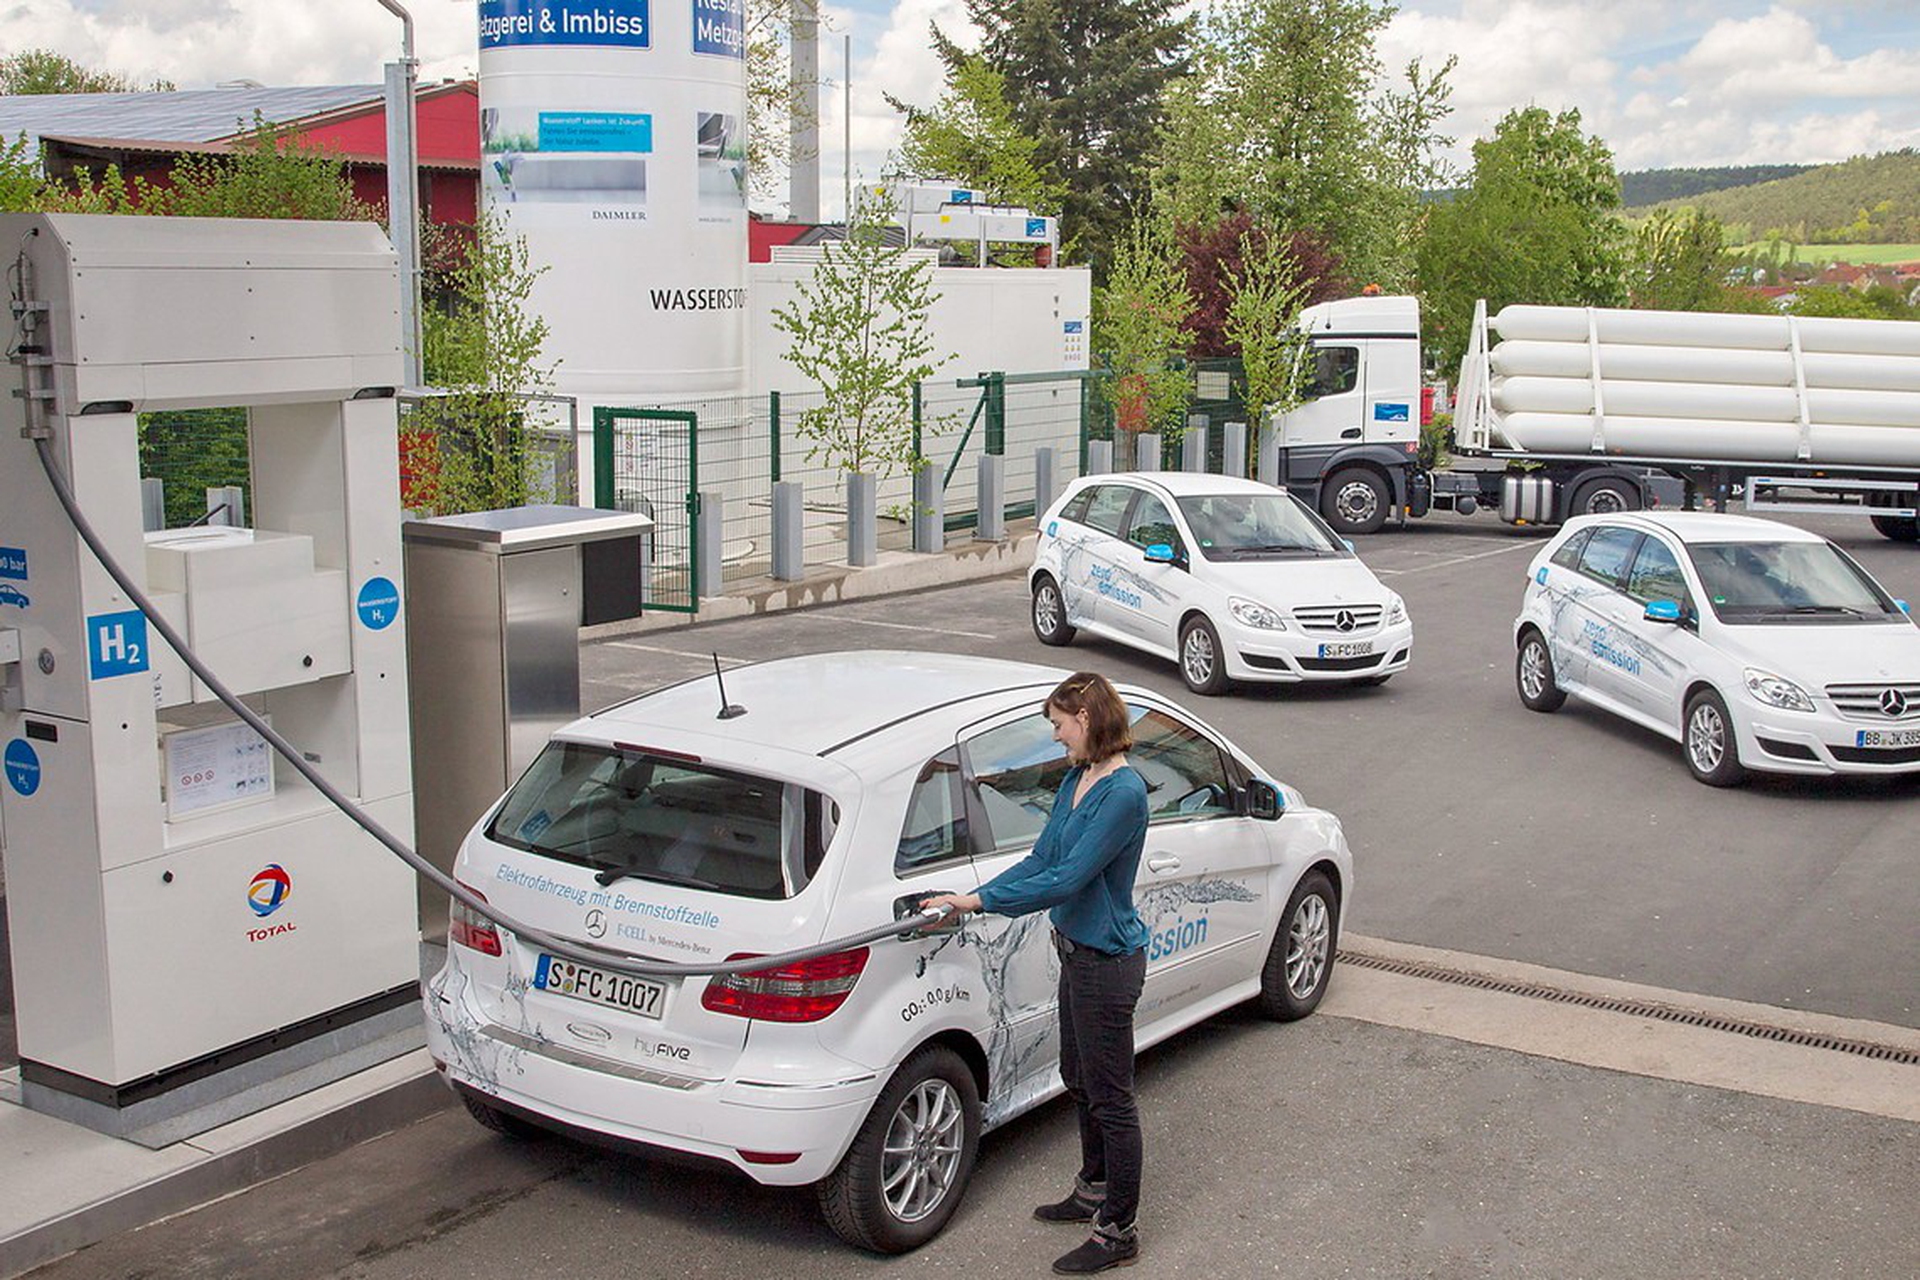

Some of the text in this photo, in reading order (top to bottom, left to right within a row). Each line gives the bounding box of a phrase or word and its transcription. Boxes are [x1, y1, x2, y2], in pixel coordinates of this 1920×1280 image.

[539, 11, 556, 33] &
[563, 8, 643, 35] Imbiss
[592, 211, 646, 221] DAIMLER
[10, 557, 25, 571] bar
[100, 623, 140, 664] H2
[1592, 640, 1641, 676] emission
[496, 863, 719, 929] Elektrofahrzeug mit Brennstoffzelle
[246, 922, 297, 942] TOTAL
[1148, 915, 1208, 961] ssion
